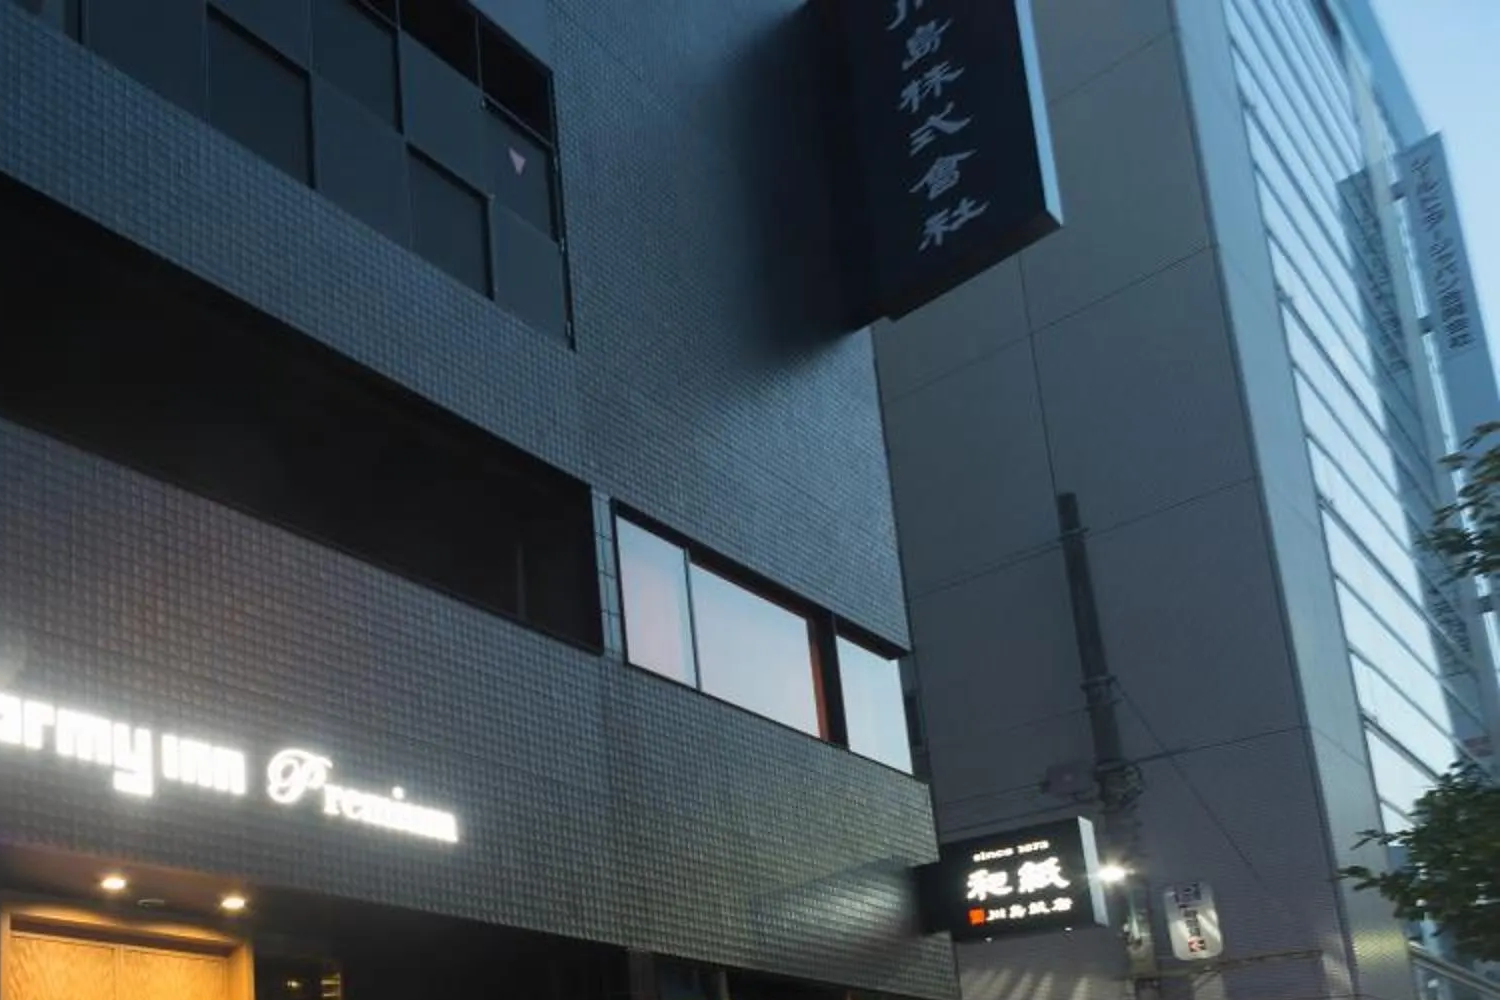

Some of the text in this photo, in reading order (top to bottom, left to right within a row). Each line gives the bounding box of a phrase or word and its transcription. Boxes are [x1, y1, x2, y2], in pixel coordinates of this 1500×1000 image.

[160, 731, 247, 796] inn
[266, 749, 460, 843] Premium
[966, 856, 1071, 901] 和紙
